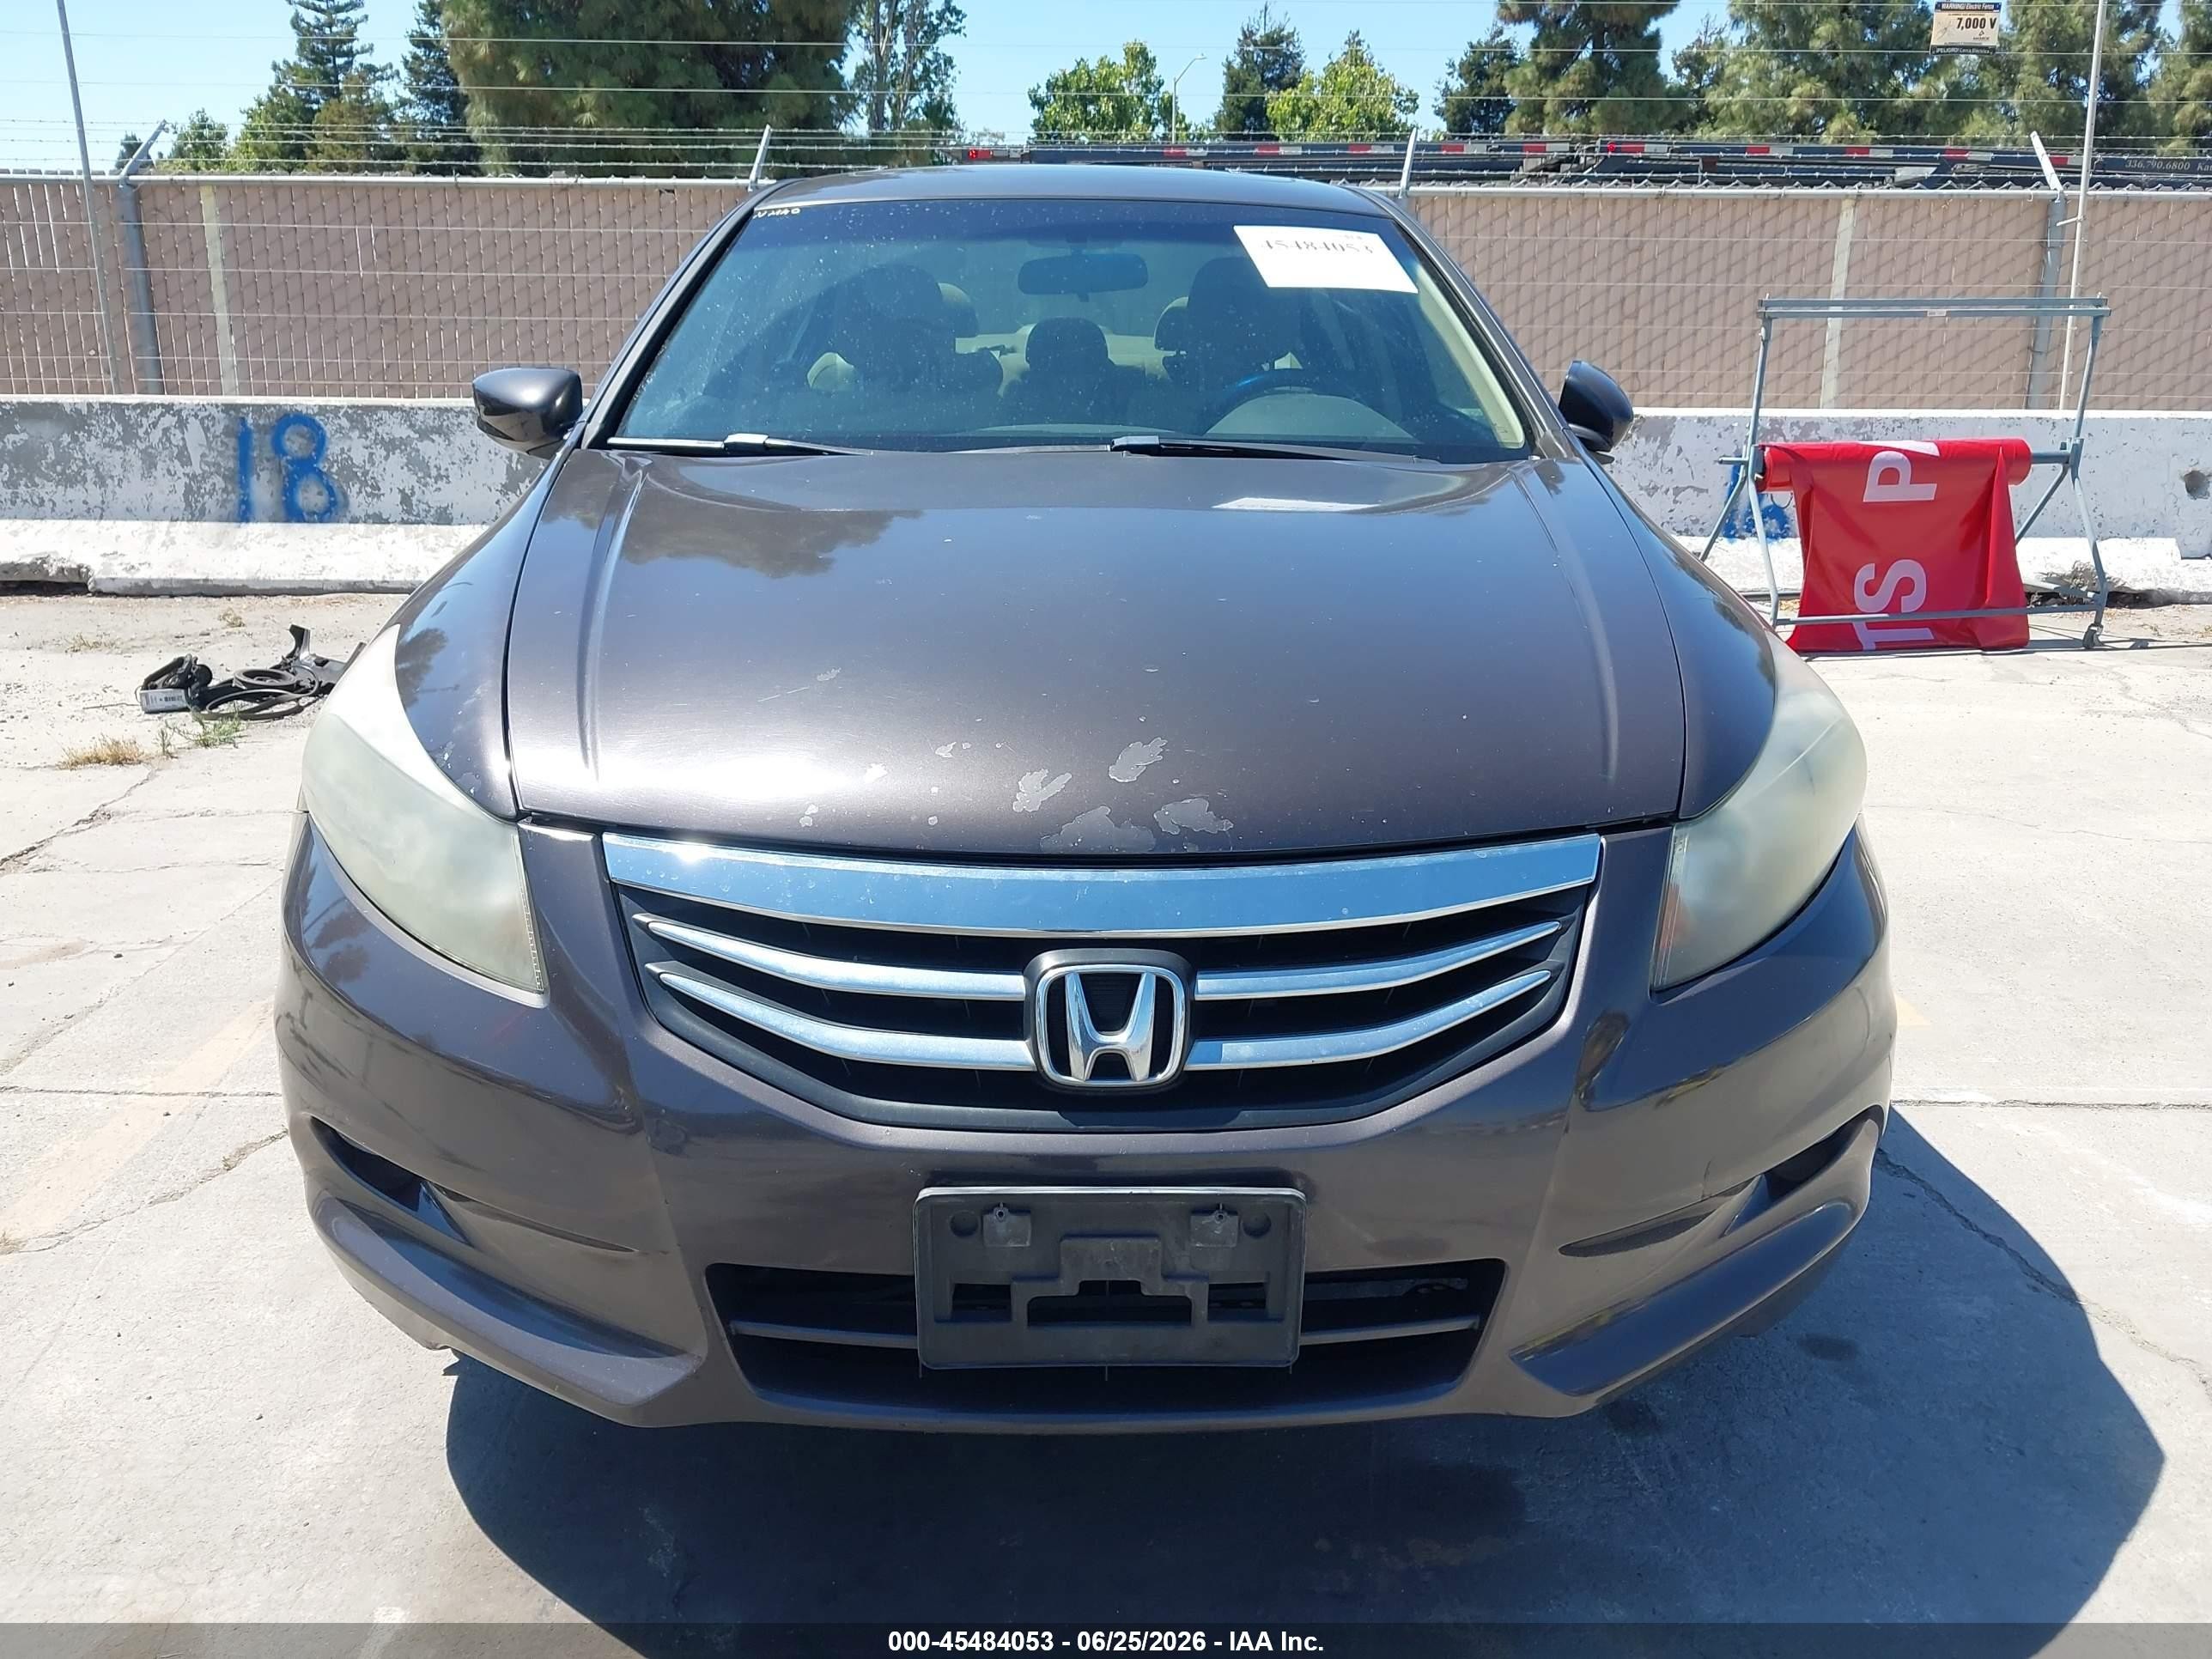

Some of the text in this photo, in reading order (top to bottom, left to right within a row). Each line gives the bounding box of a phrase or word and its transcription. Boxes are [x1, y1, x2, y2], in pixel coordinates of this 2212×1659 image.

[1957, 17, 1997, 30] 7,000 V
[238, 413, 338, 523] 18
